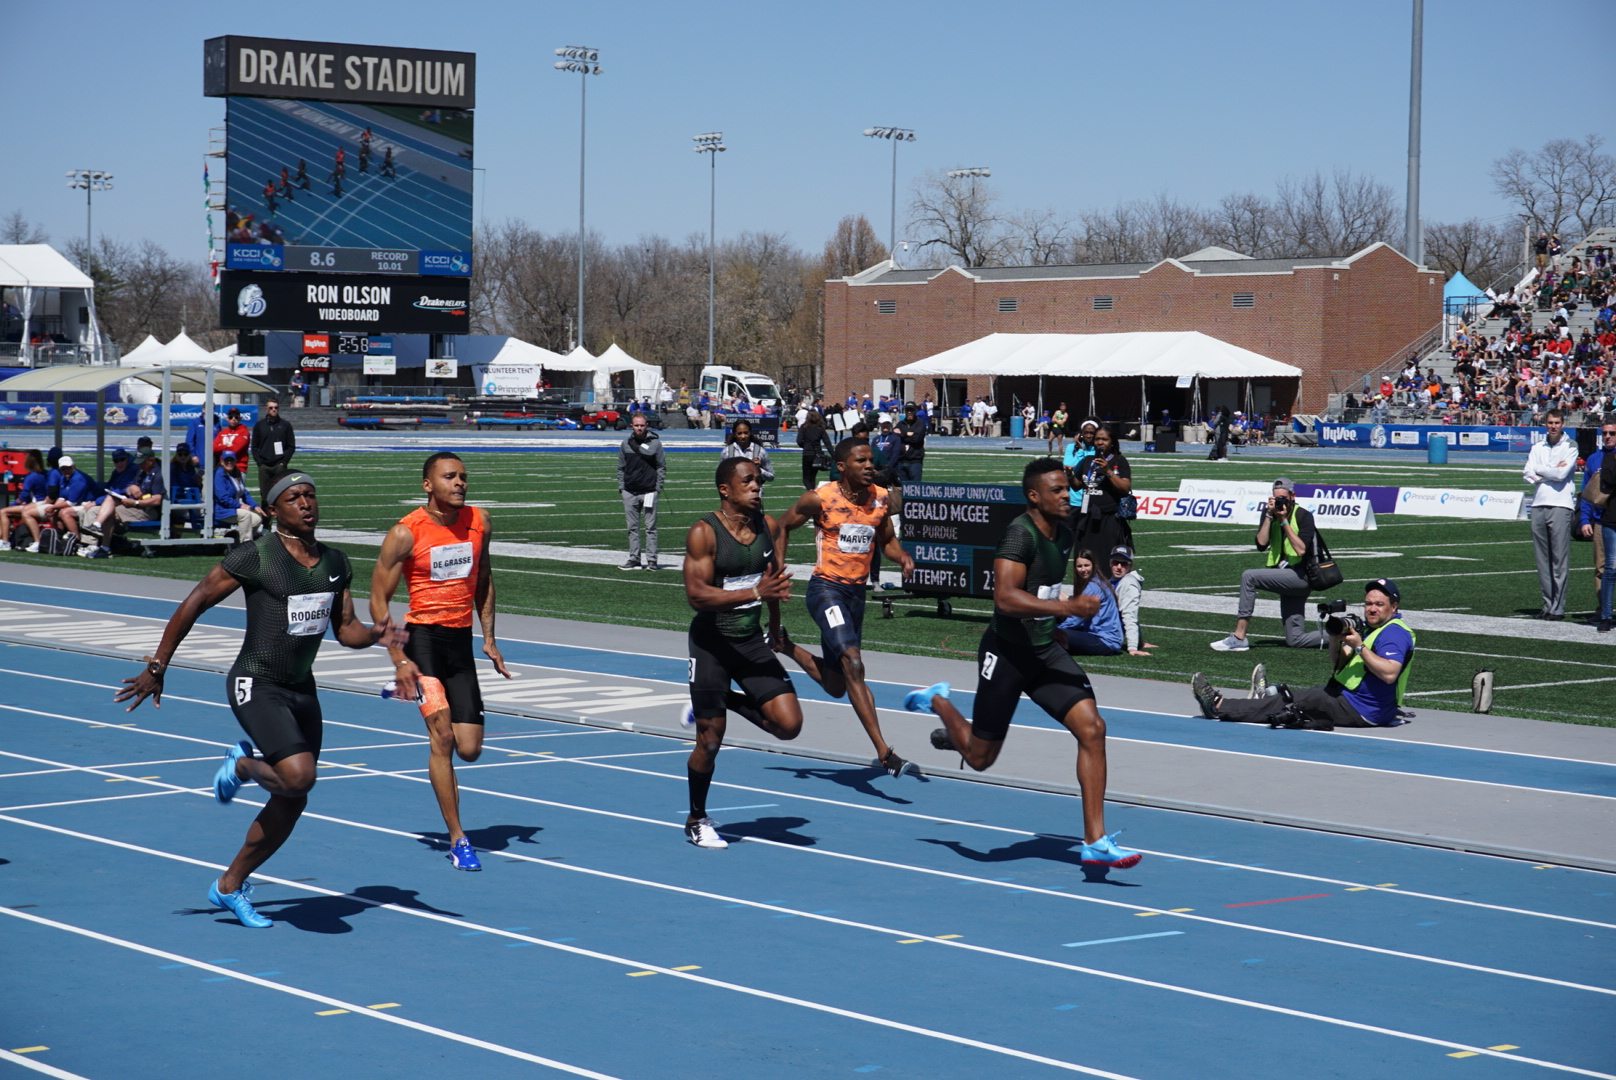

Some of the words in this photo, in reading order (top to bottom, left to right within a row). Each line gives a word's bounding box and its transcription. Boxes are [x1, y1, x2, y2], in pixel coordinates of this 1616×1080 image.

[239, 47, 335, 89] DRAKE
[344, 55, 466, 97] STADIUM
[233, 249, 260, 258] KCCI
[310, 251, 336, 267] 8.6
[371, 251, 409, 261] RECORD
[424, 255, 450, 264] KCCI
[377, 261, 403, 271] 10.01
[307, 284, 338, 304] RON
[343, 285, 391, 305] OLSON
[318, 307, 380, 322] VIDEOBOARD
[338, 337, 369, 353] 2:58
[478, 367, 517, 375] VOLUNTEER
[497, 384, 532, 395] Principal
[902, 484, 921, 497] MEN
[921, 485, 943, 498] LONG
[943, 486, 966, 499] JUMP
[966, 487, 1006, 502] UNIV/COL
[903, 501, 948, 521] GERALD
[950, 503, 990, 523] MCGEE
[1317, 503, 1362, 517] DMOS
[840, 534, 872, 544] HARVEY
[903, 523, 915, 537] SR
[922, 525, 958, 540] PURDUE
[915, 545, 950, 562] PLACE:
[951, 548, 958, 562] 3
[433, 560, 443, 569] DE
[444, 556, 472, 568] GRASSE
[904, 568, 957, 588] TTEMPT:
[959, 572, 967, 588] 6
[983, 570, 995, 591] 2
[291, 607, 330, 622] RODGERS
[829, 607, 840, 625] 1
[983, 654, 994, 678] 2
[238, 678, 247, 703] 5
